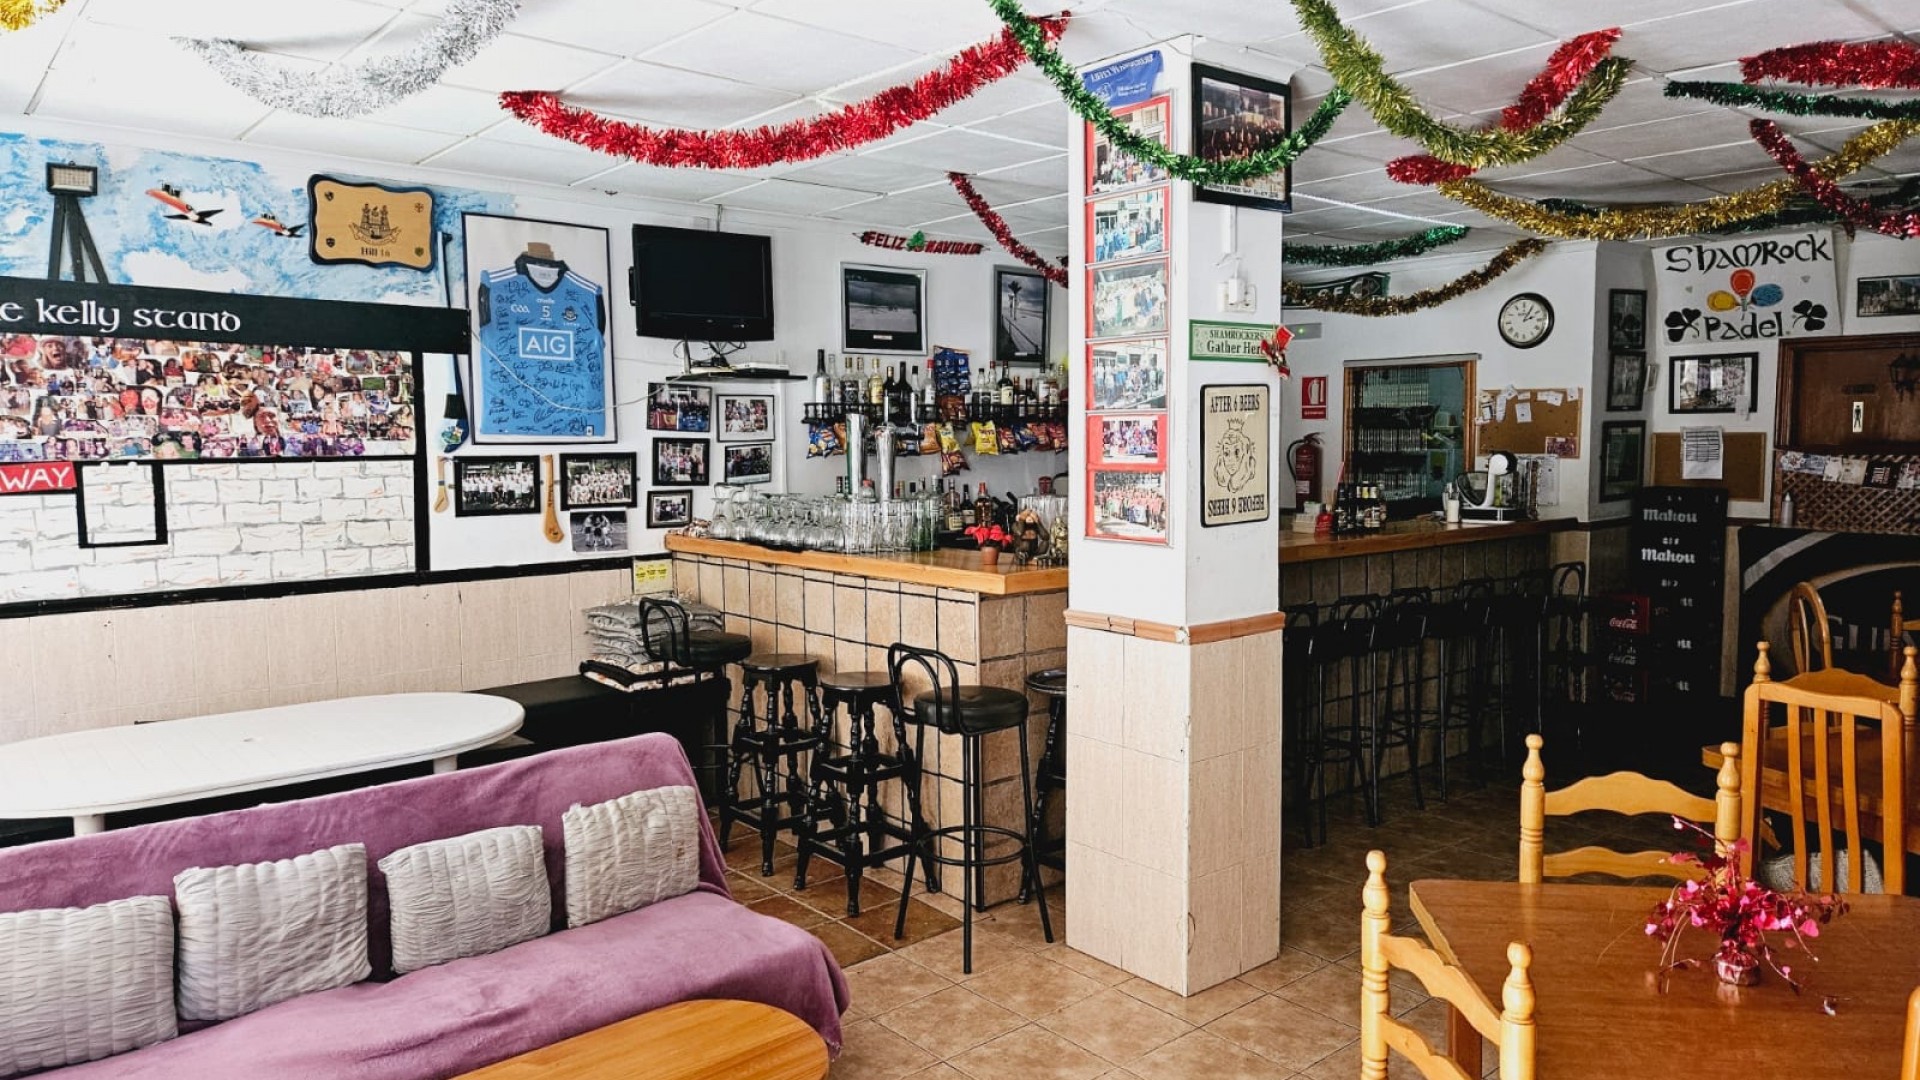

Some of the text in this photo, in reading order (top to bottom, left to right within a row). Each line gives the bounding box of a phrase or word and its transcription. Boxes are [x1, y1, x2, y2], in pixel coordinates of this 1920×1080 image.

[866, 231, 907, 250] FELIZ
[0, 298, 241, 333] e kelly stand
[541, 305, 551, 318] 5
[1703, 312, 1784, 341] Padel
[526, 335, 566, 355] AIG
[1206, 340, 1263, 355] Gather Her
[1210, 395, 1232, 413] AFTER
[1240, 394, 1260, 412] BEERS
[0, 466, 70, 491] WAY
[1208, 498, 1230, 518] BEERS
[1238, 494, 1265, 513] BEFORE
[1643, 508, 1698, 523] Mahou
[1641, 548, 1696, 564] Mahou
